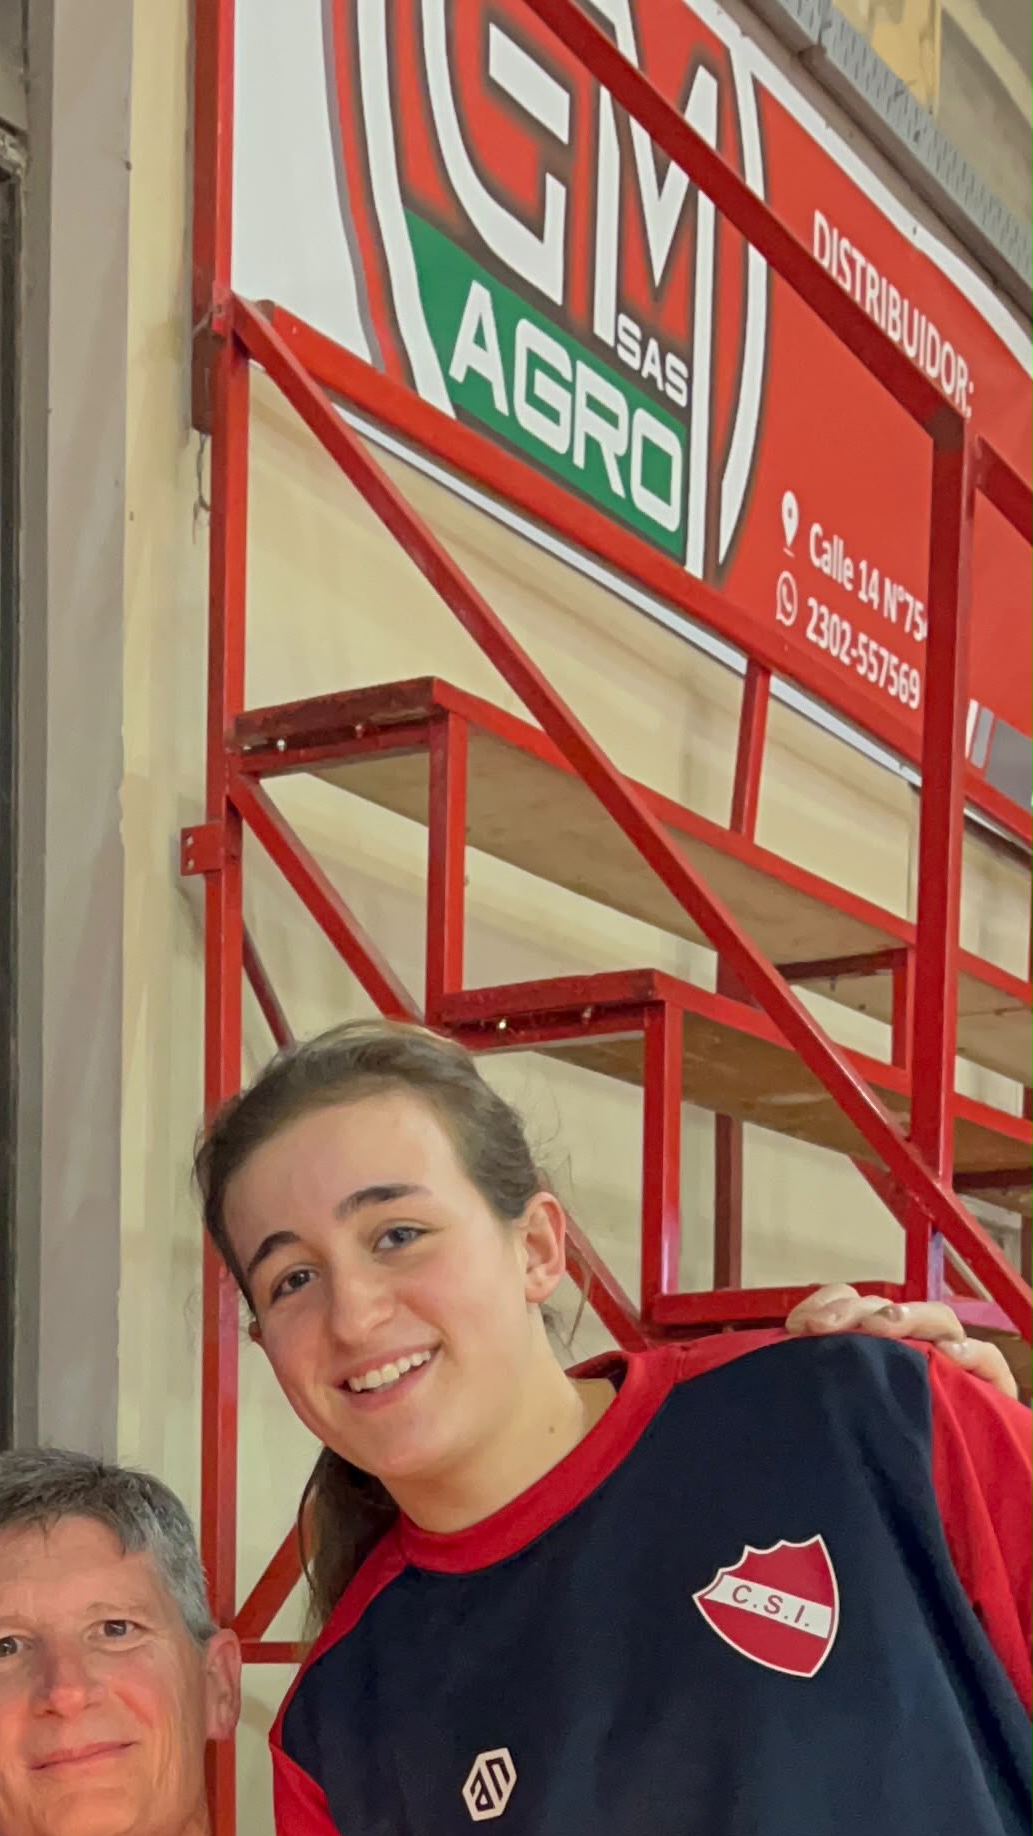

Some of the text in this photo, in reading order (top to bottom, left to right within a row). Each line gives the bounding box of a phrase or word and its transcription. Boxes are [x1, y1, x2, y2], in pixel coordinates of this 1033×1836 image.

[617, 313, 689, 408] SAS
[813, 209, 974, 419] DISTRIBUIDOR:
[449, 279, 683, 532] AGRO
[809, 522, 854, 591] Calle
[858, 560, 880, 610] 14
[806, 597, 921, 710] 2302-557569
[732, 1584, 809, 1627] C.S.I.
